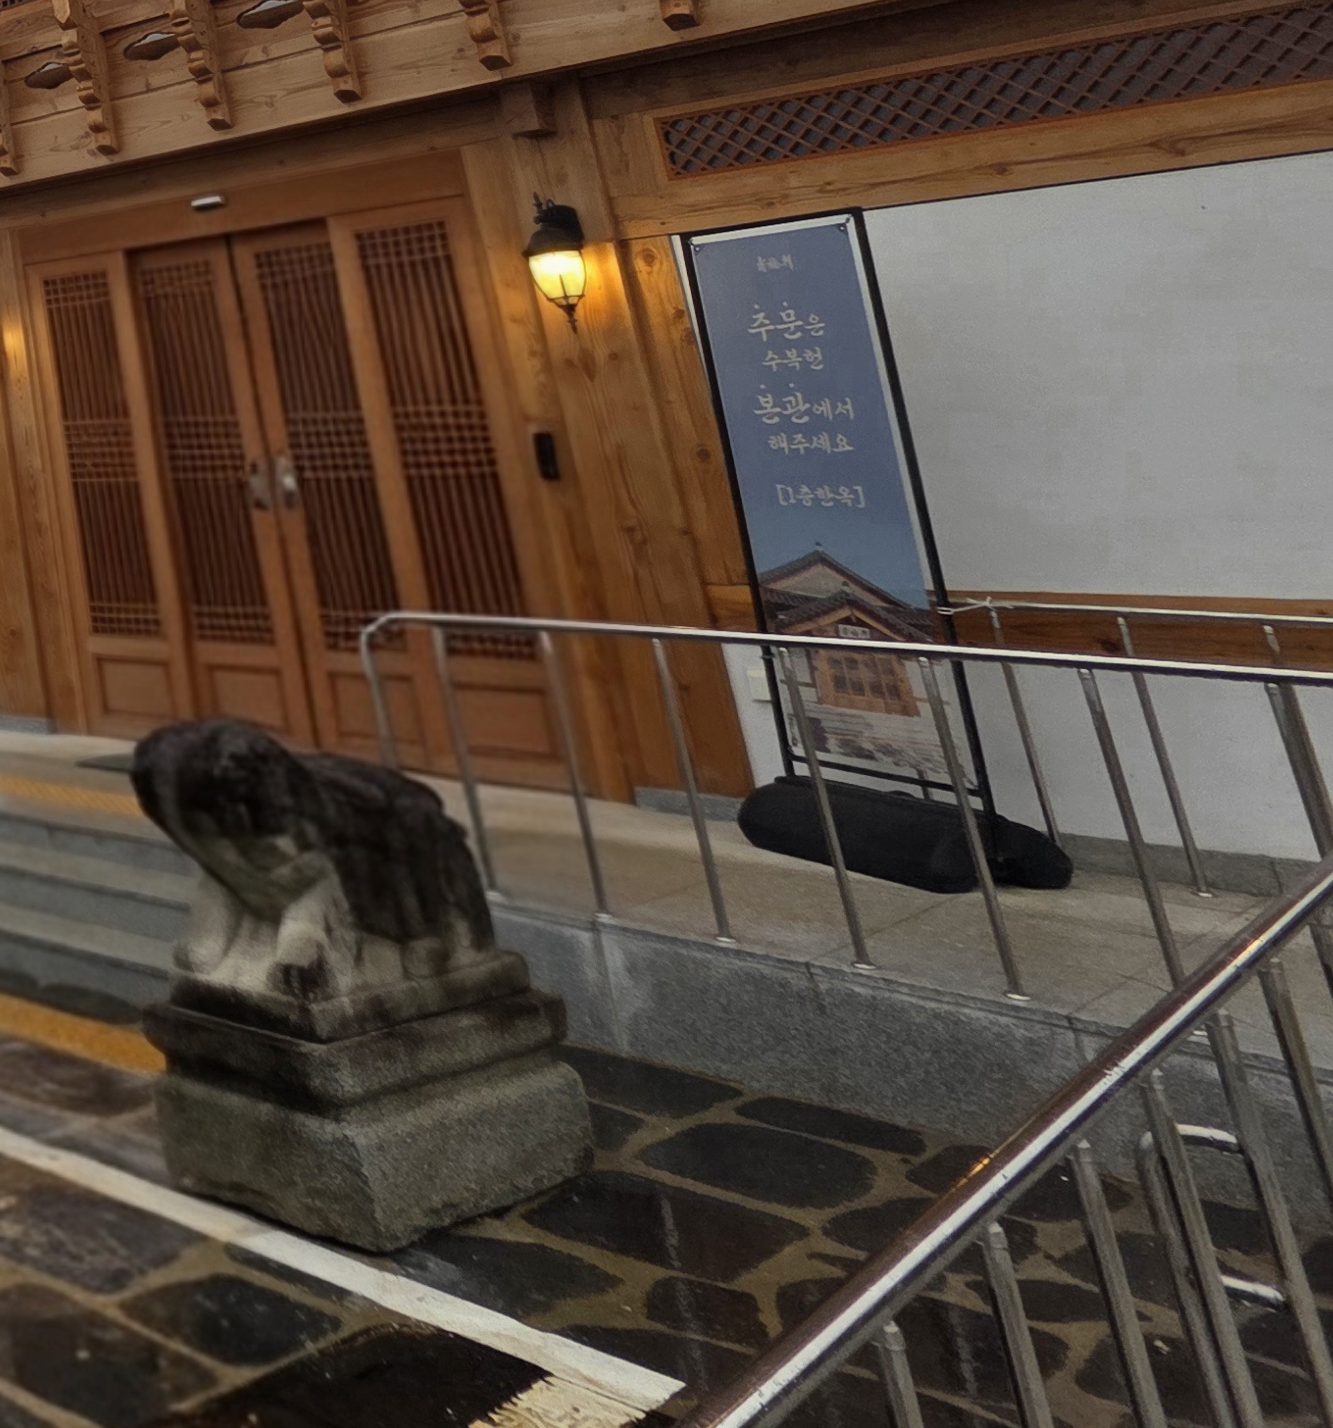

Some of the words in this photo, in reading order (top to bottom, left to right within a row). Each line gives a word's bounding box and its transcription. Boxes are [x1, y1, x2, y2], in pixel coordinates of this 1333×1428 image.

[747, 308, 825, 342] 주문은
[762, 346, 824, 372] 수복헌
[753, 390, 854, 424] 본관에서
[767, 431, 854, 455] 해주세요
